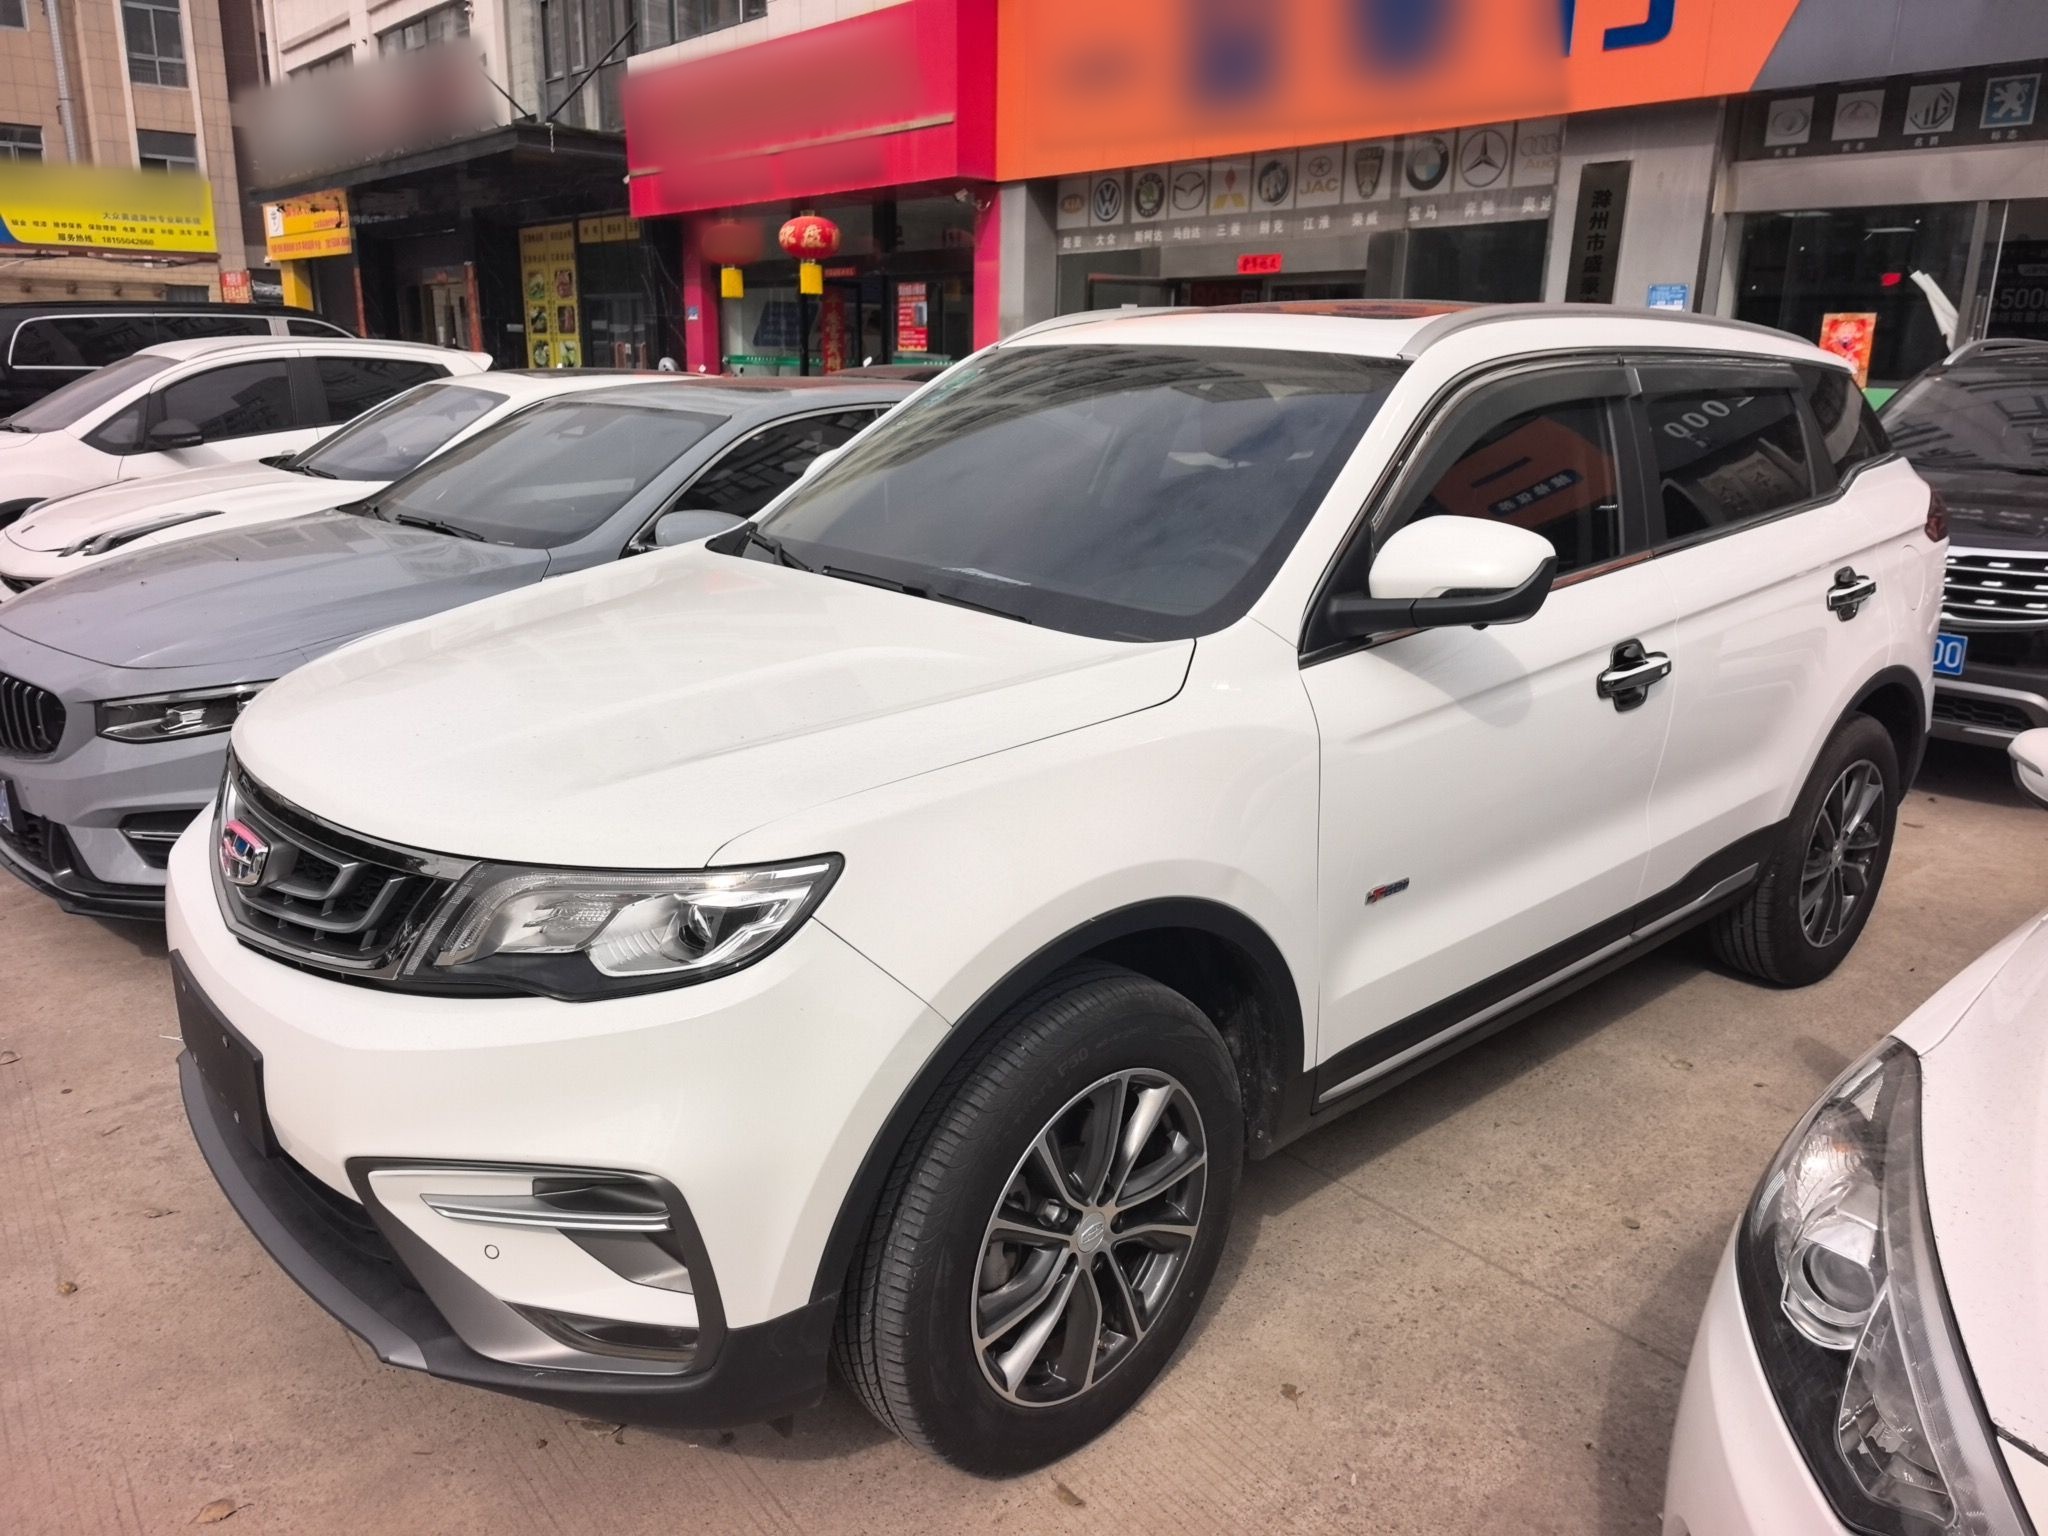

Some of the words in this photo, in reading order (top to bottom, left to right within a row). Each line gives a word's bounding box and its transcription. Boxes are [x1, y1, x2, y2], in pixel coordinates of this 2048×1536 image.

[1300, 177, 1339, 194] JAC
[1095, 232, 1117, 246] 大众
[1134, 229, 1163, 243] 斯柯达
[1172, 225, 1201, 240] 马自达
[1216, 222, 1241, 237] 三菱
[1259, 218, 1284, 234] 别克
[1303, 214, 1331, 230] 江淮
[1408, 204, 1438, 222] 宝马
[1464, 199, 1495, 218] 奔驰
[1521, 195, 1552, 213] 奥迪
